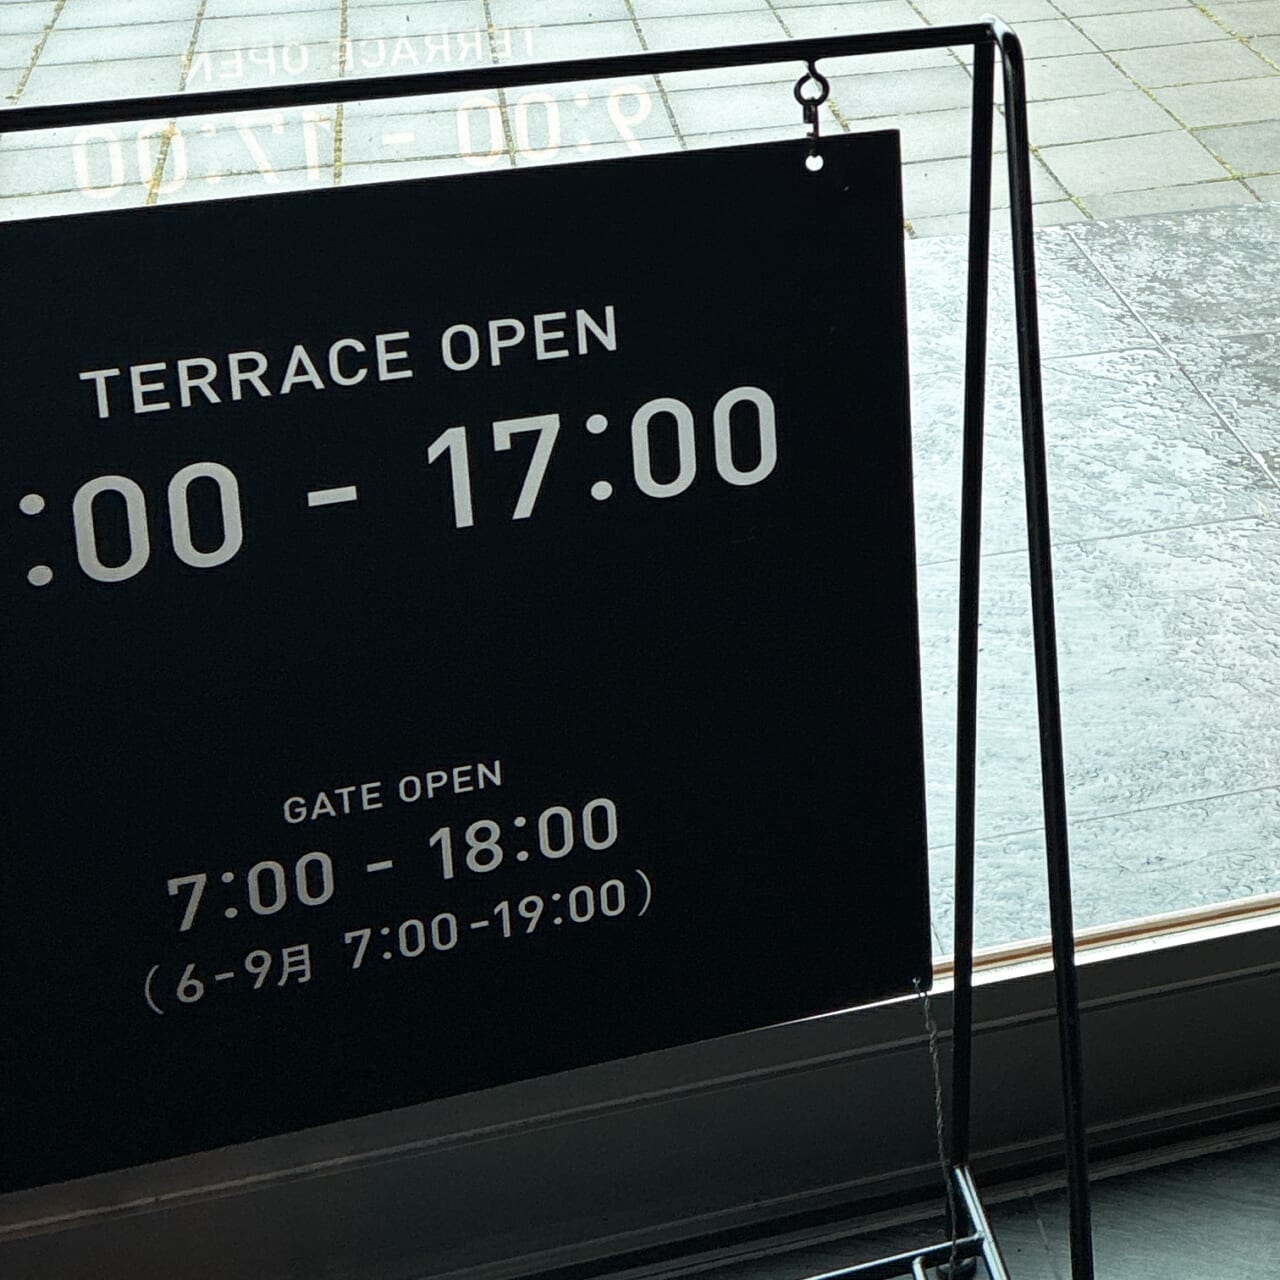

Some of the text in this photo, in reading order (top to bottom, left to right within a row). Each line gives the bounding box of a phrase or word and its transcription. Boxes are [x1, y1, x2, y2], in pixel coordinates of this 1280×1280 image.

[79, 305, 618, 419] TERRACE OPEN
[427, 386, 778, 529] 17:00
[283, 760, 501, 824] GATE OPEN
[167, 851, 334, 931] 7:00
[429, 797, 618, 880] 18:00
